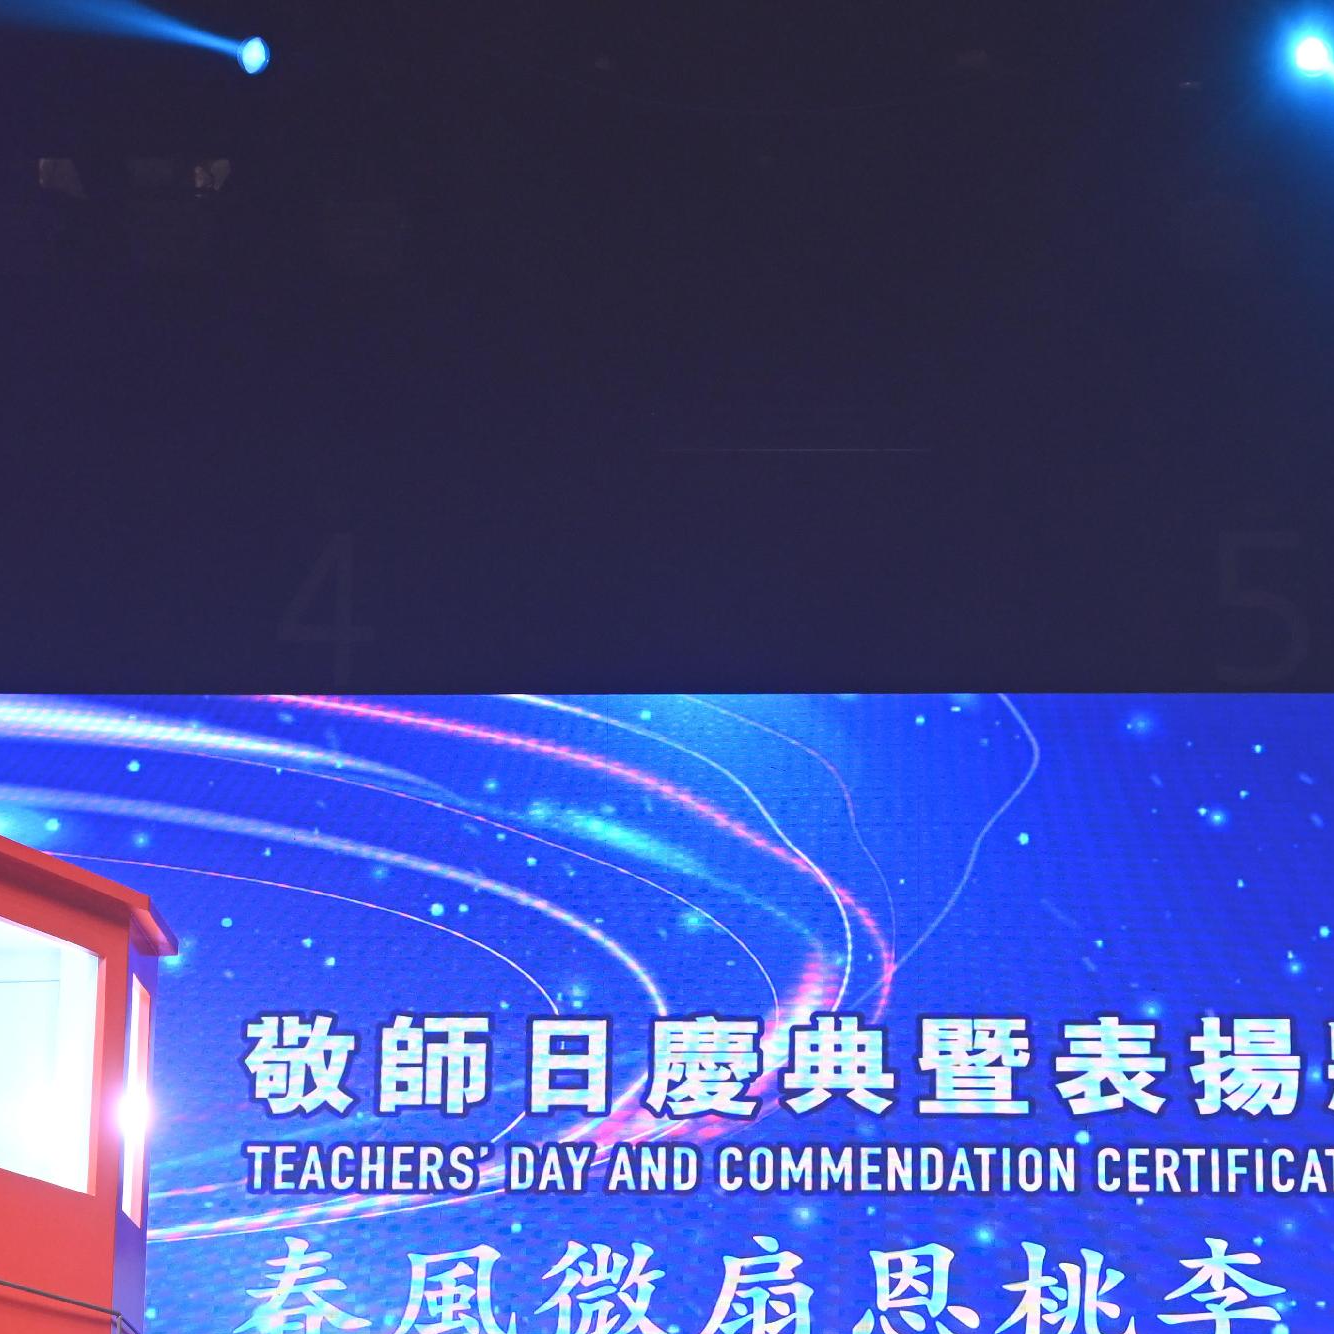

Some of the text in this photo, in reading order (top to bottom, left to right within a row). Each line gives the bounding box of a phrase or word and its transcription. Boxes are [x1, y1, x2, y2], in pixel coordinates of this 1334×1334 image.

[246, 1143, 493, 1192] TEACHERS’
[509, 1145, 592, 1192] DAY
[607, 1145, 699, 1192] AND
[718, 1146, 1076, 1194] COMMENDATION
